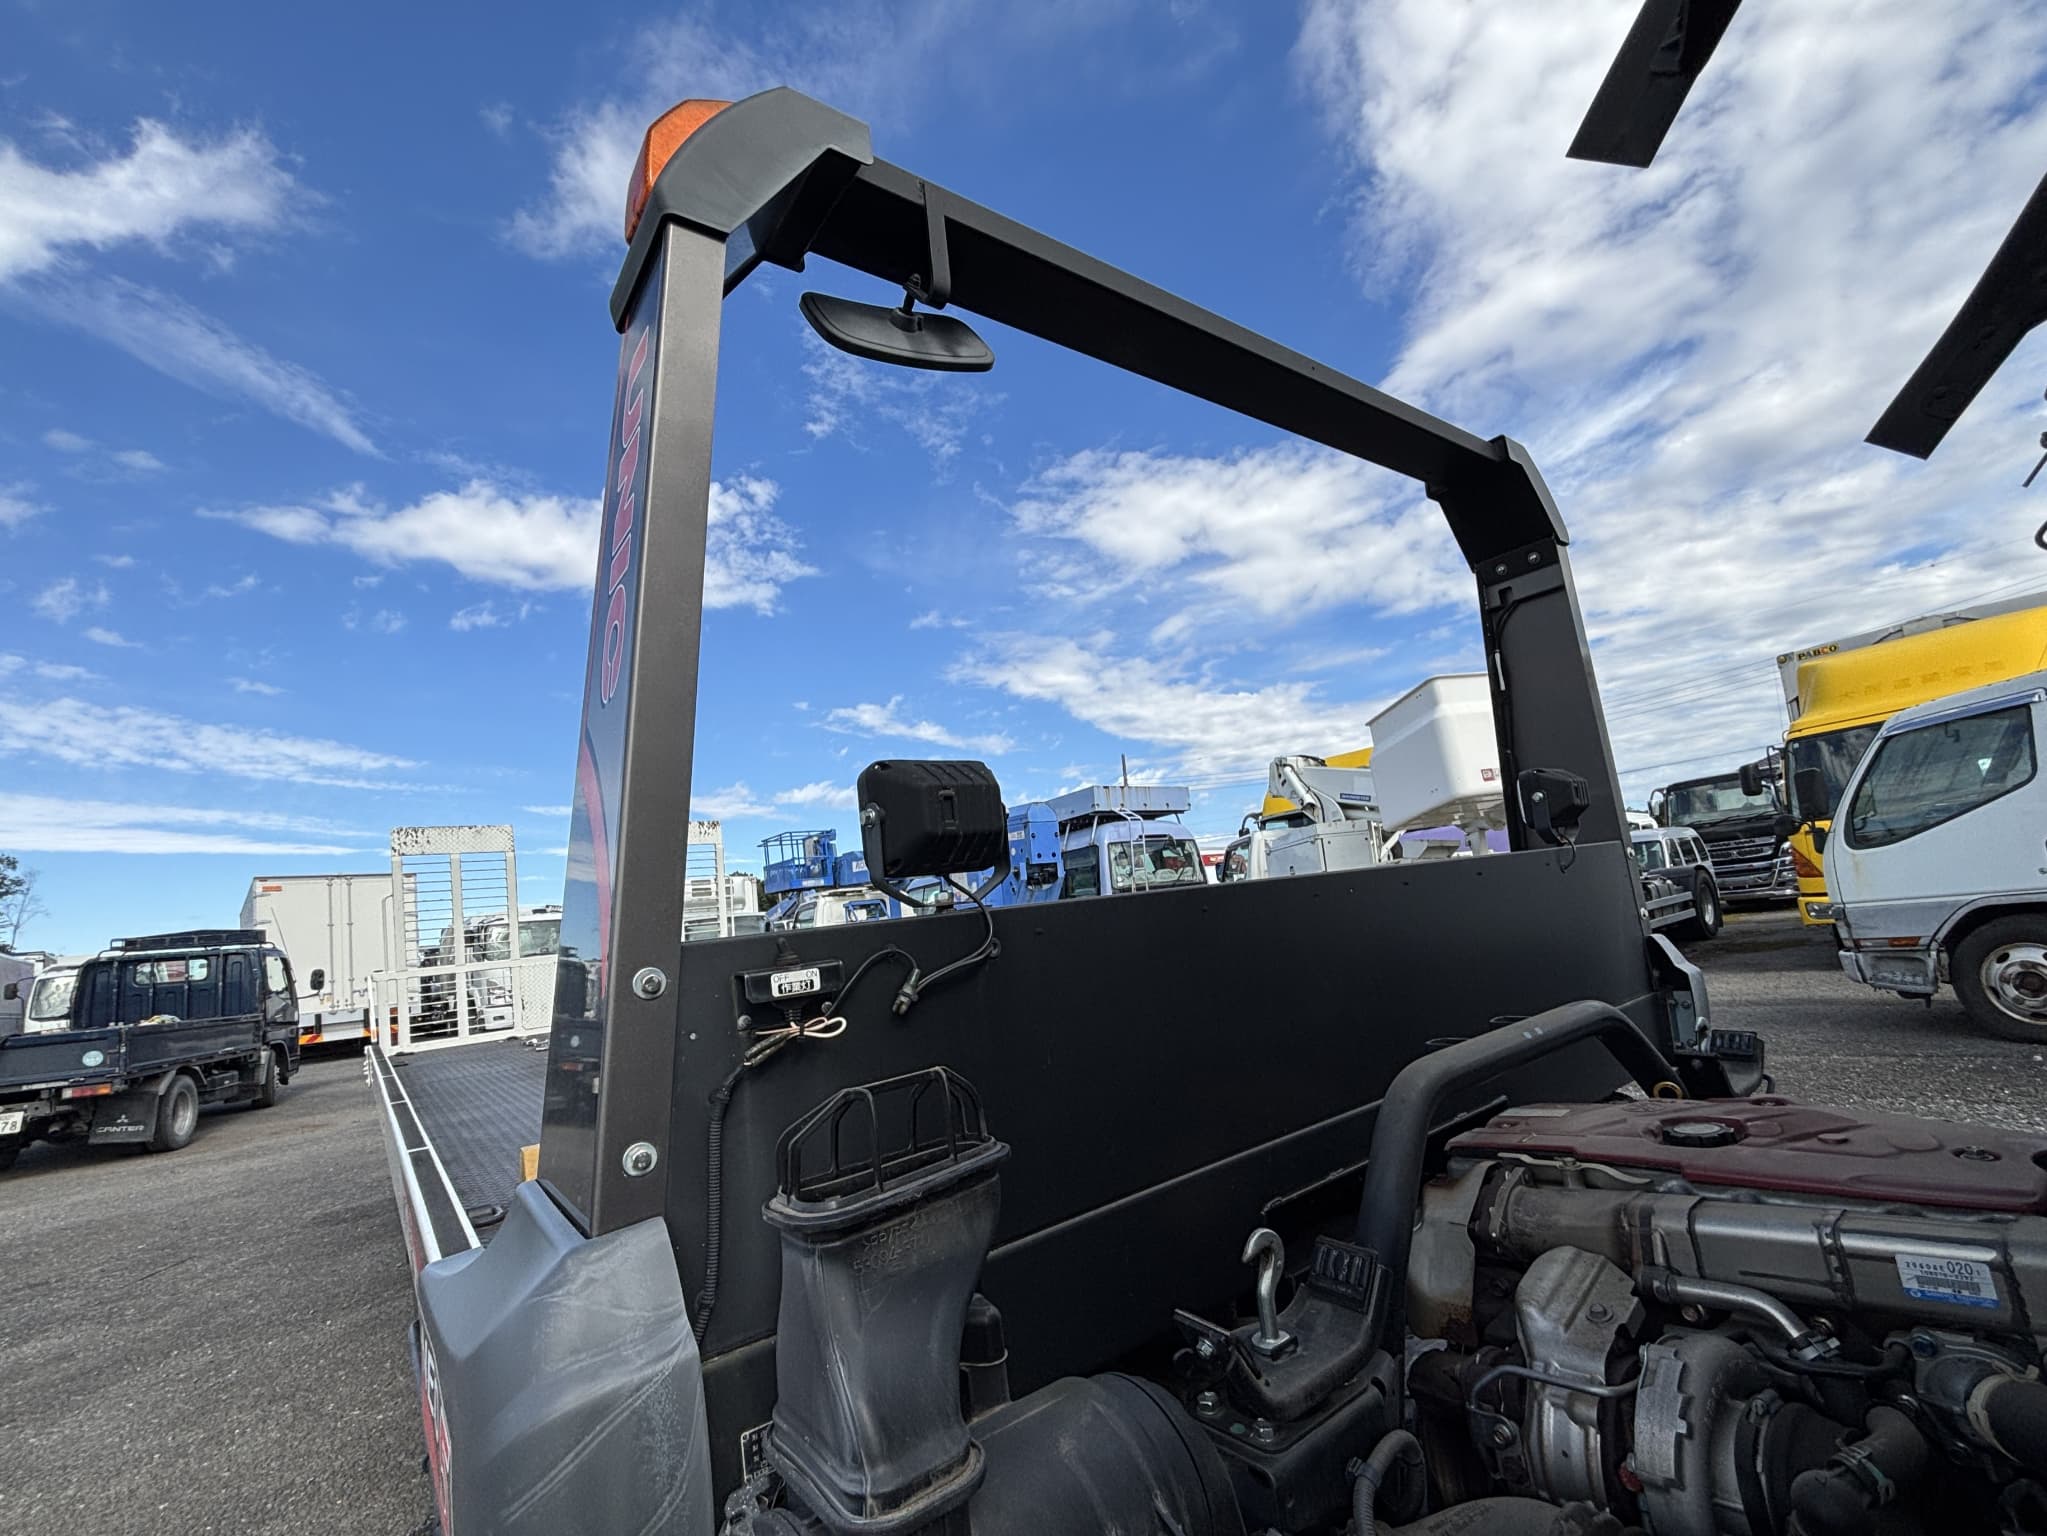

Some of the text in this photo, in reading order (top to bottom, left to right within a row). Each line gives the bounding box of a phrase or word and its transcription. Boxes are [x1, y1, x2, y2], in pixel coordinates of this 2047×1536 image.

[602, 326, 650, 704] UNIC
[1798, 645, 1837, 660] PABCO
[773, 970, 818, 983] OFF ON
